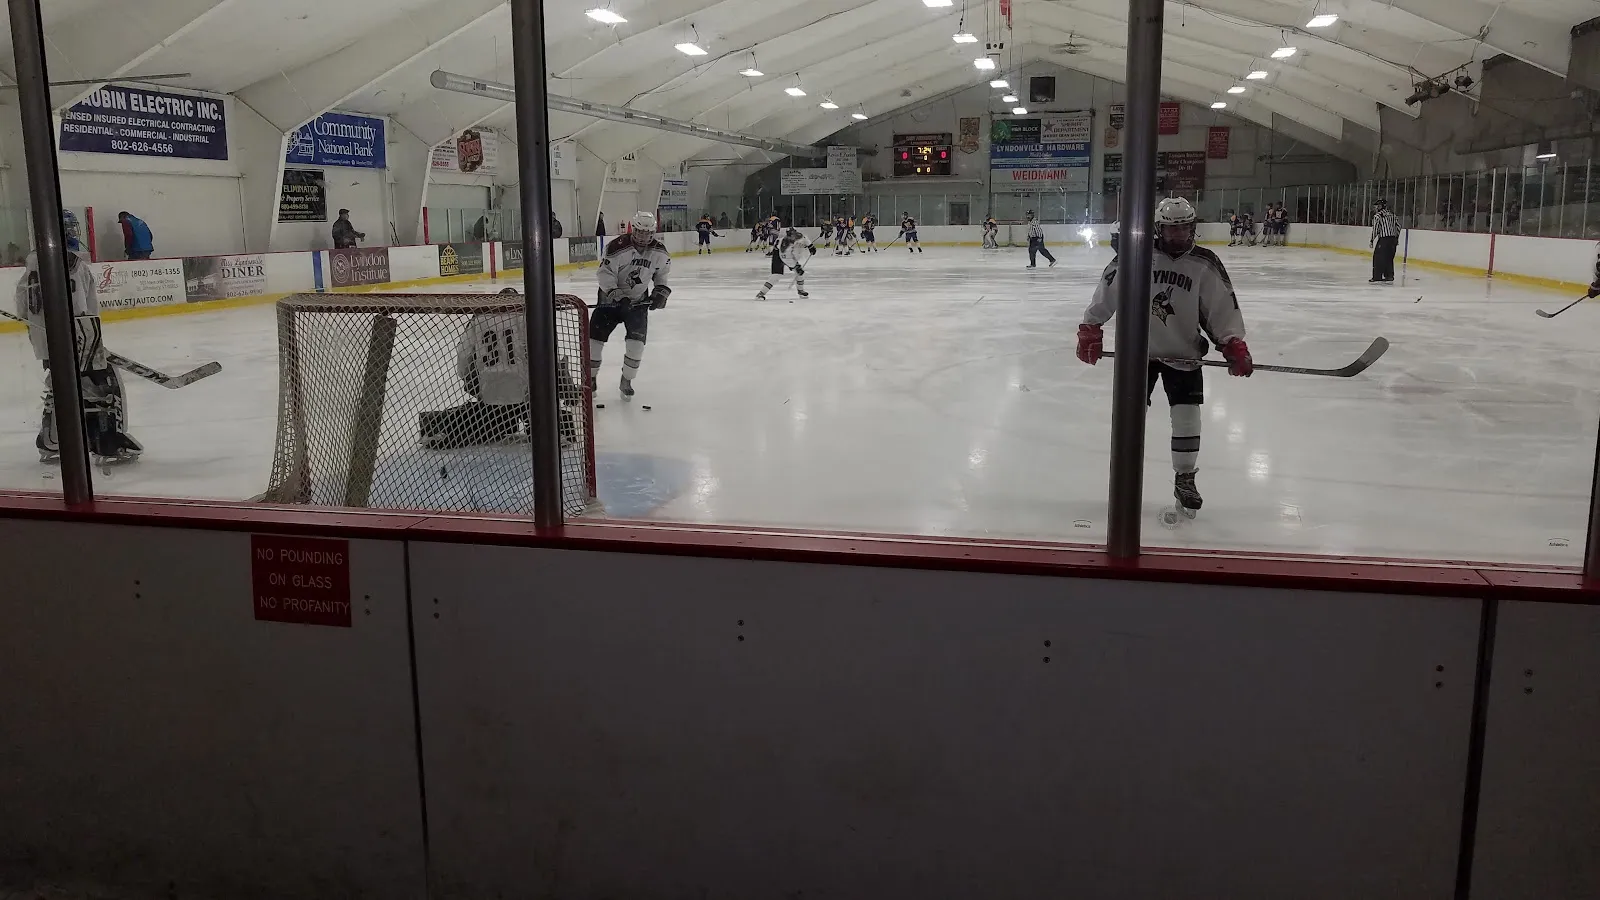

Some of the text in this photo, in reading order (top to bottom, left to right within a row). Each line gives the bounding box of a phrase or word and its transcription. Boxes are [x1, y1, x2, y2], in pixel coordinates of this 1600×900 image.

[130, 93, 193, 118] ELECTRIC
[197, 102, 222, 121] INC.
[93, 114, 127, 125] INSURED
[128, 117, 170, 129] ELECTRICAL
[171, 121, 216, 133] CONTRACTING
[313, 116, 376, 147] Community
[63, 123, 114, 136] RESIDENTIAL
[120, 129, 167, 140] COMMERCIAL
[172, 132, 209, 144] INDUSTRIAL
[111, 140, 173, 153] 802-626-4556
[318, 139, 374, 157] National Bank
[996, 143, 1085, 152] LYNDONVILLE HARDWARE
[1012, 170, 1067, 180] WEIDMANN
[283, 185, 319, 193] ELIMINATOR
[350, 253, 386, 270] Lyndon
[131, 267, 181, 278] (802) 748-1355
[221, 265, 265, 279] DINER
[351, 268, 388, 281] Institute
[1153, 270, 1193, 292] YNDON
[99, 294, 174, 308] WWW.STJAUTO.COM
[257, 548, 343, 565] NO POUNDING
[269, 572, 332, 589] ON GLASS
[260, 596, 350, 615] NO PROFANITY
